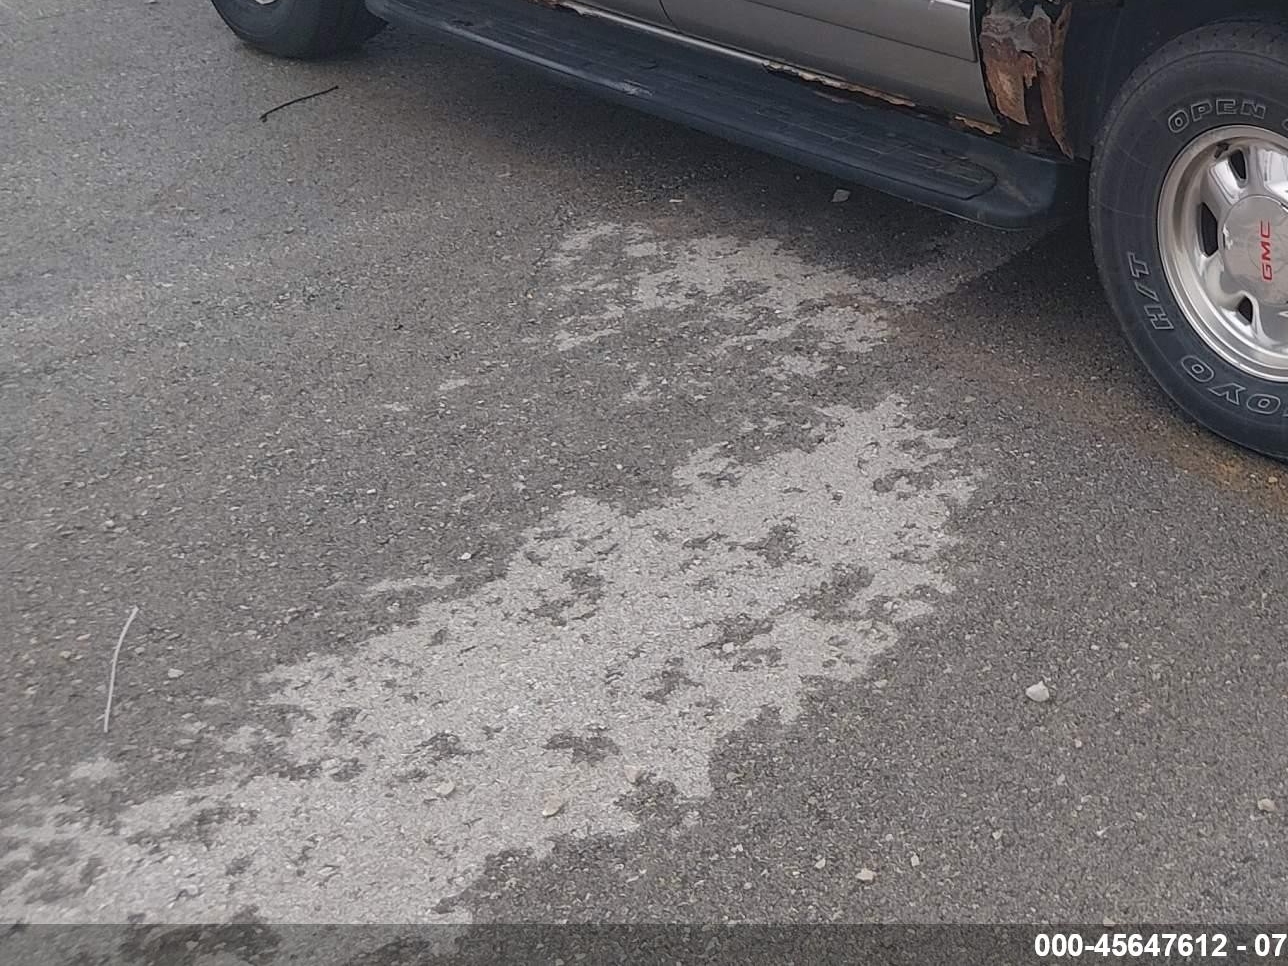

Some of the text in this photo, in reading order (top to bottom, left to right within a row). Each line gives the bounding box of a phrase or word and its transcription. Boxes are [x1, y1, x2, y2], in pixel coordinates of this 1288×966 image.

[1168, 98, 1266, 133] OPEN
[1260, 220, 1273, 281] GMC
[1127, 251, 1174, 331] H/T
